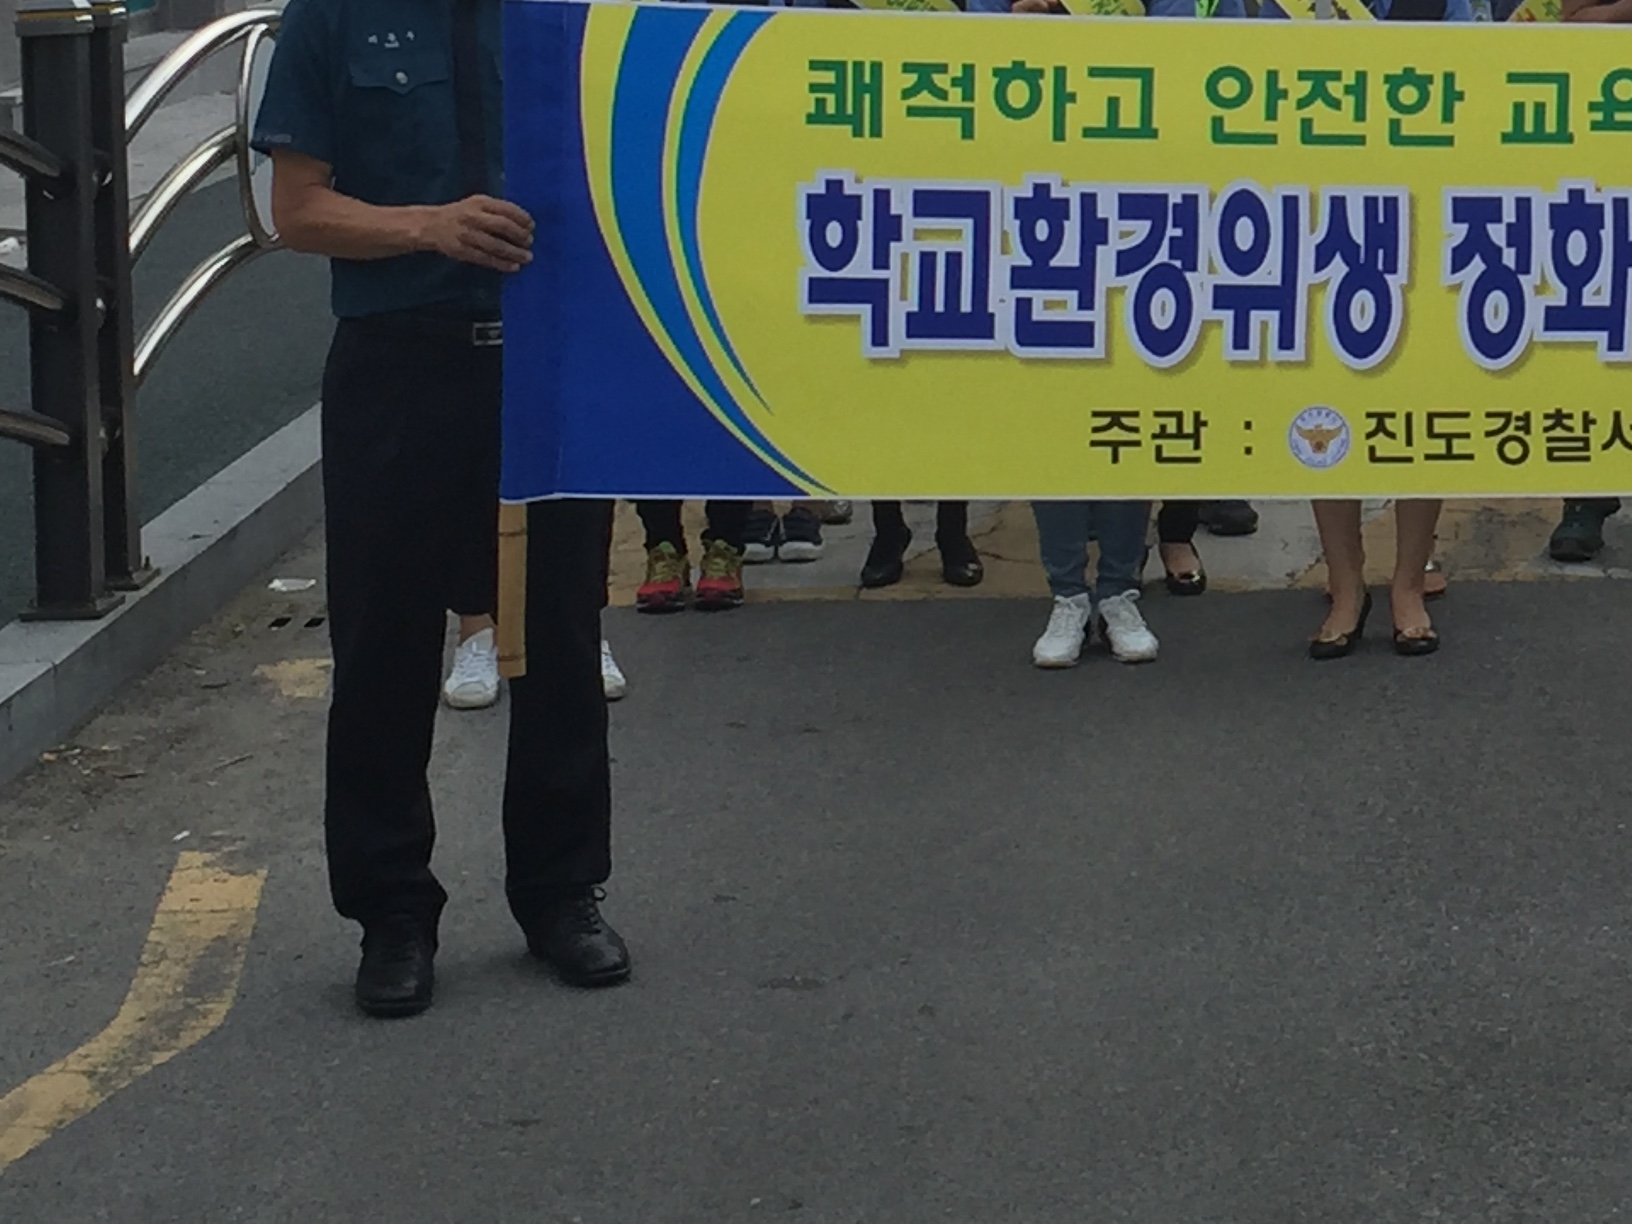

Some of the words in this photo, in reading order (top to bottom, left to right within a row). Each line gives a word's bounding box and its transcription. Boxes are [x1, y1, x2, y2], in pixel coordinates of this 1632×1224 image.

[805, 58, 1160, 142] 쾌적하고
[1203, 64, 1465, 148] 안전한
[800, 173, 1402, 366] 학교환경위생
[1089, 409, 1209, 465] 주관
